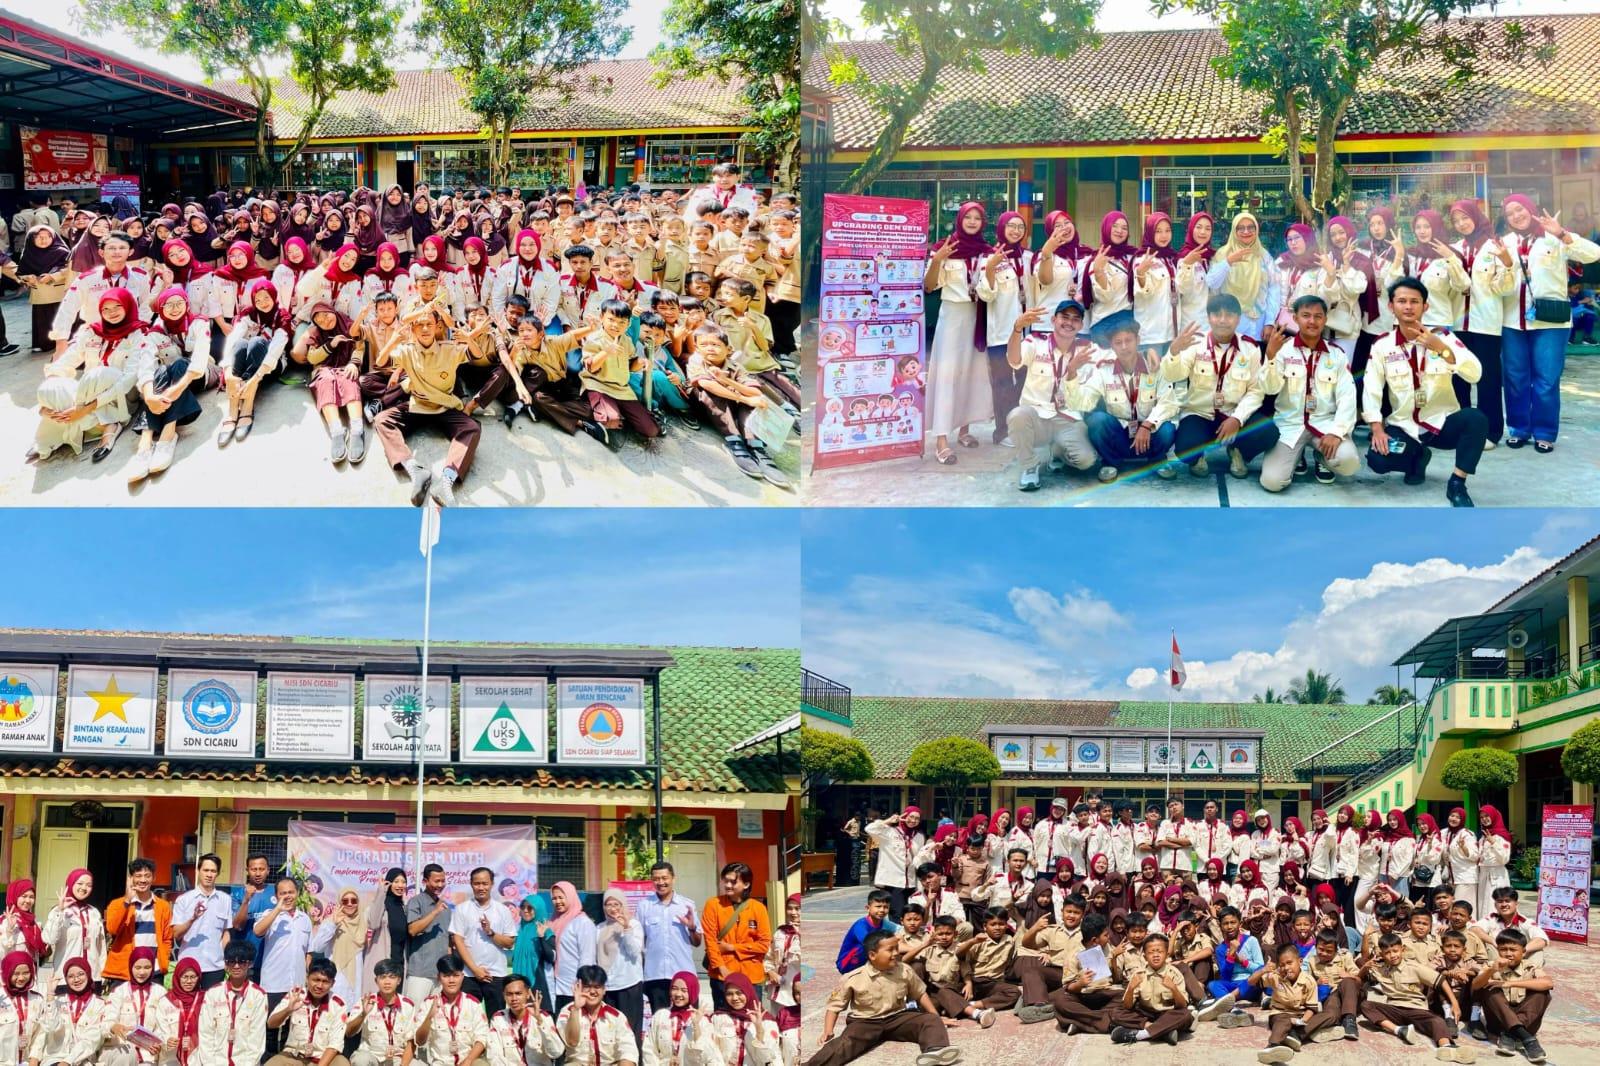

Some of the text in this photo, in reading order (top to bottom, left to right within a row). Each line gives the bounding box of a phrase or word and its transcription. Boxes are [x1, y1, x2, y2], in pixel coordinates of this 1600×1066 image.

[832, 221, 882, 230] UPGRADING
[474, 688, 533, 696] SEKOLAH SEHAT
[379, 685, 436, 712] ADIWIYTA
[74, 725, 145, 734] BINTANG KEAMANAN
[494, 730, 514, 738] UKS
[73, 735, 102, 743] PANGAN
[184, 737, 238, 747] SDN CICARIU
[372, 743, 402, 751] SEKOLAH
[336, 850, 413, 864] UPGRADING
[449, 852, 484, 864] UBTH
